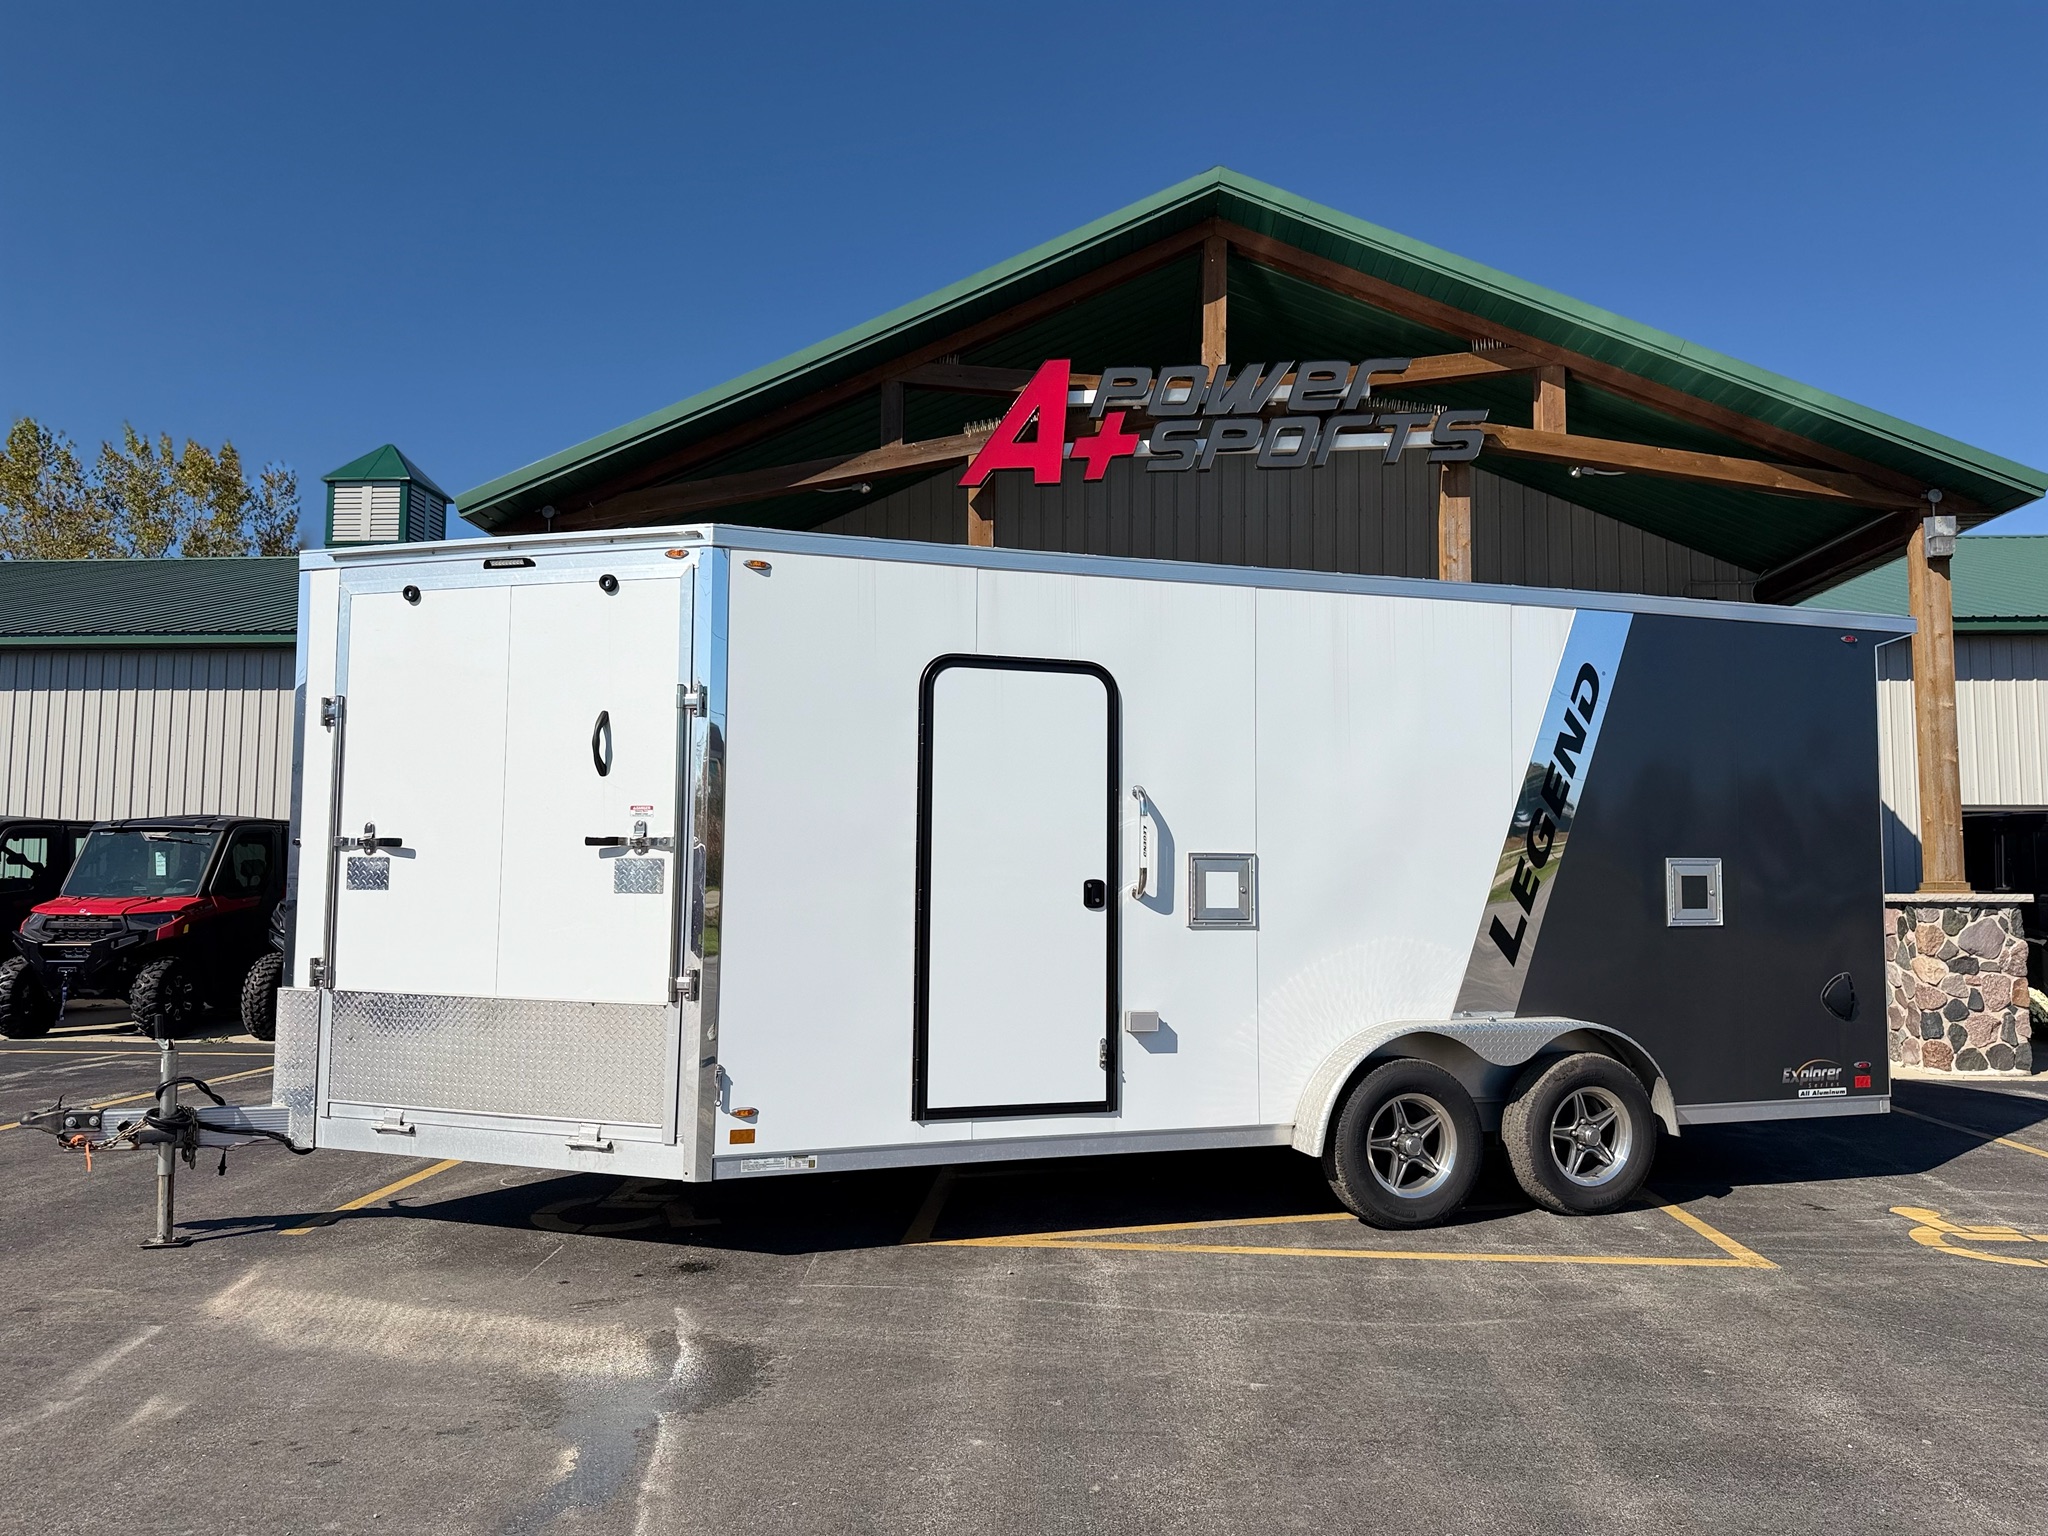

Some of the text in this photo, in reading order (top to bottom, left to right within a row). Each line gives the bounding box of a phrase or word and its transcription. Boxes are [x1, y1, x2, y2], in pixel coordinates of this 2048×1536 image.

[1488, 662, 1600, 968] LEGEND
[1781, 1066, 1842, 1086] Explorer
[1808, 1081, 1840, 1089] Series
